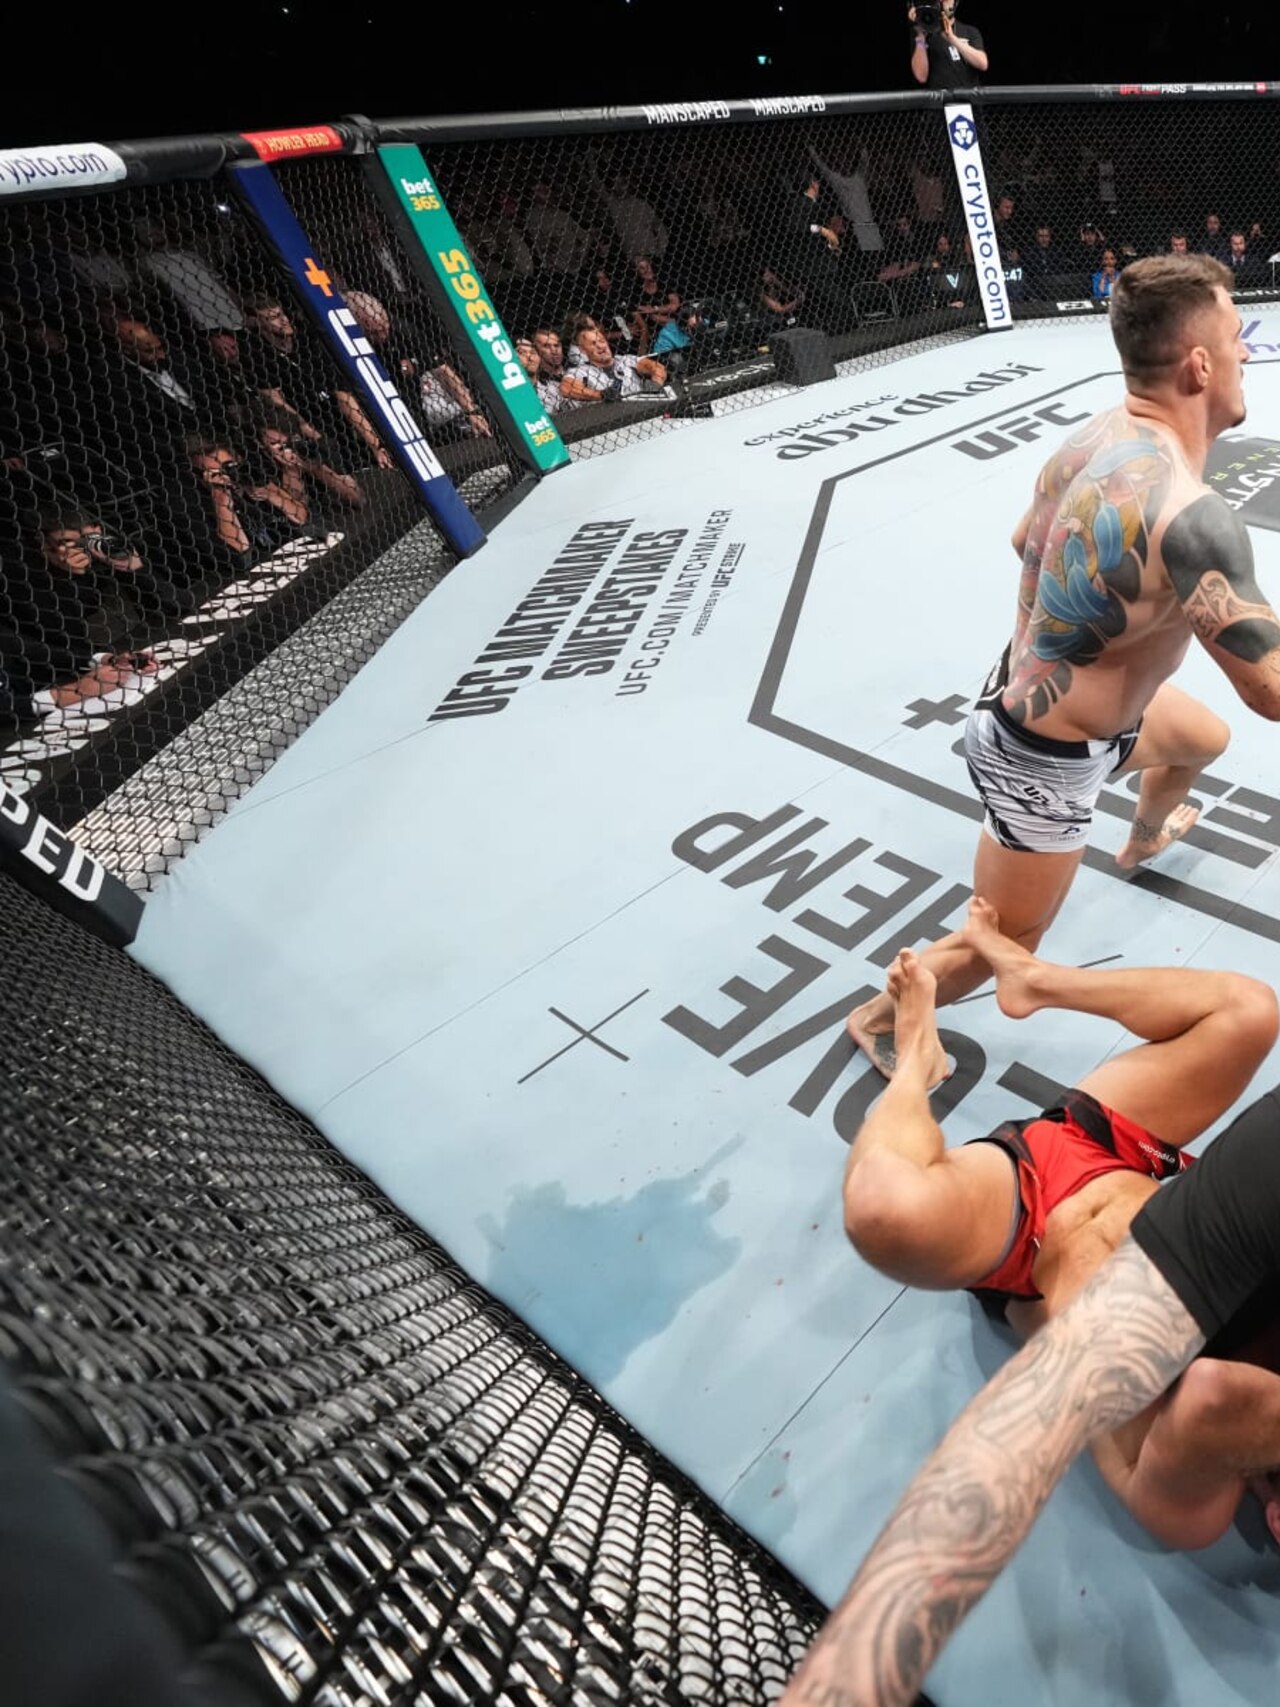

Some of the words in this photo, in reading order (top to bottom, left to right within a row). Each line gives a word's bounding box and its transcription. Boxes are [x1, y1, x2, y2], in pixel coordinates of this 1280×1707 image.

[749, 96, 827, 117] MANSCAPED
[1161, 84, 1187, 94] PASS
[643, 100, 731, 125] MANSCAPED
[266, 135, 303, 151] HOWLER
[304, 132, 330, 148] HEAD
[0, 152, 108, 185] ypto.com
[401, 178, 434, 195] bet
[410, 195, 441, 211] 365
[965, 163, 1007, 322] crypto.com
[1002, 268, 1022, 281] :47
[438, 248, 526, 390] bet365
[304, 258, 445, 482] ESPN+
[524, 416, 550, 435] bet
[744, 393, 899, 447] experience
[776, 414, 902, 460] abu
[893, 361, 1046, 416] dhabi
[951, 402, 1092, 460] UFC
[531, 430, 556, 447] 365
[473, 518, 636, 665] MATCHMAKER
[541, 528, 689, 680] SWEEPSTAKES
[615, 509, 733, 697] UFC.COM/MATCHMAKER
[426, 665, 534, 722] UFC
